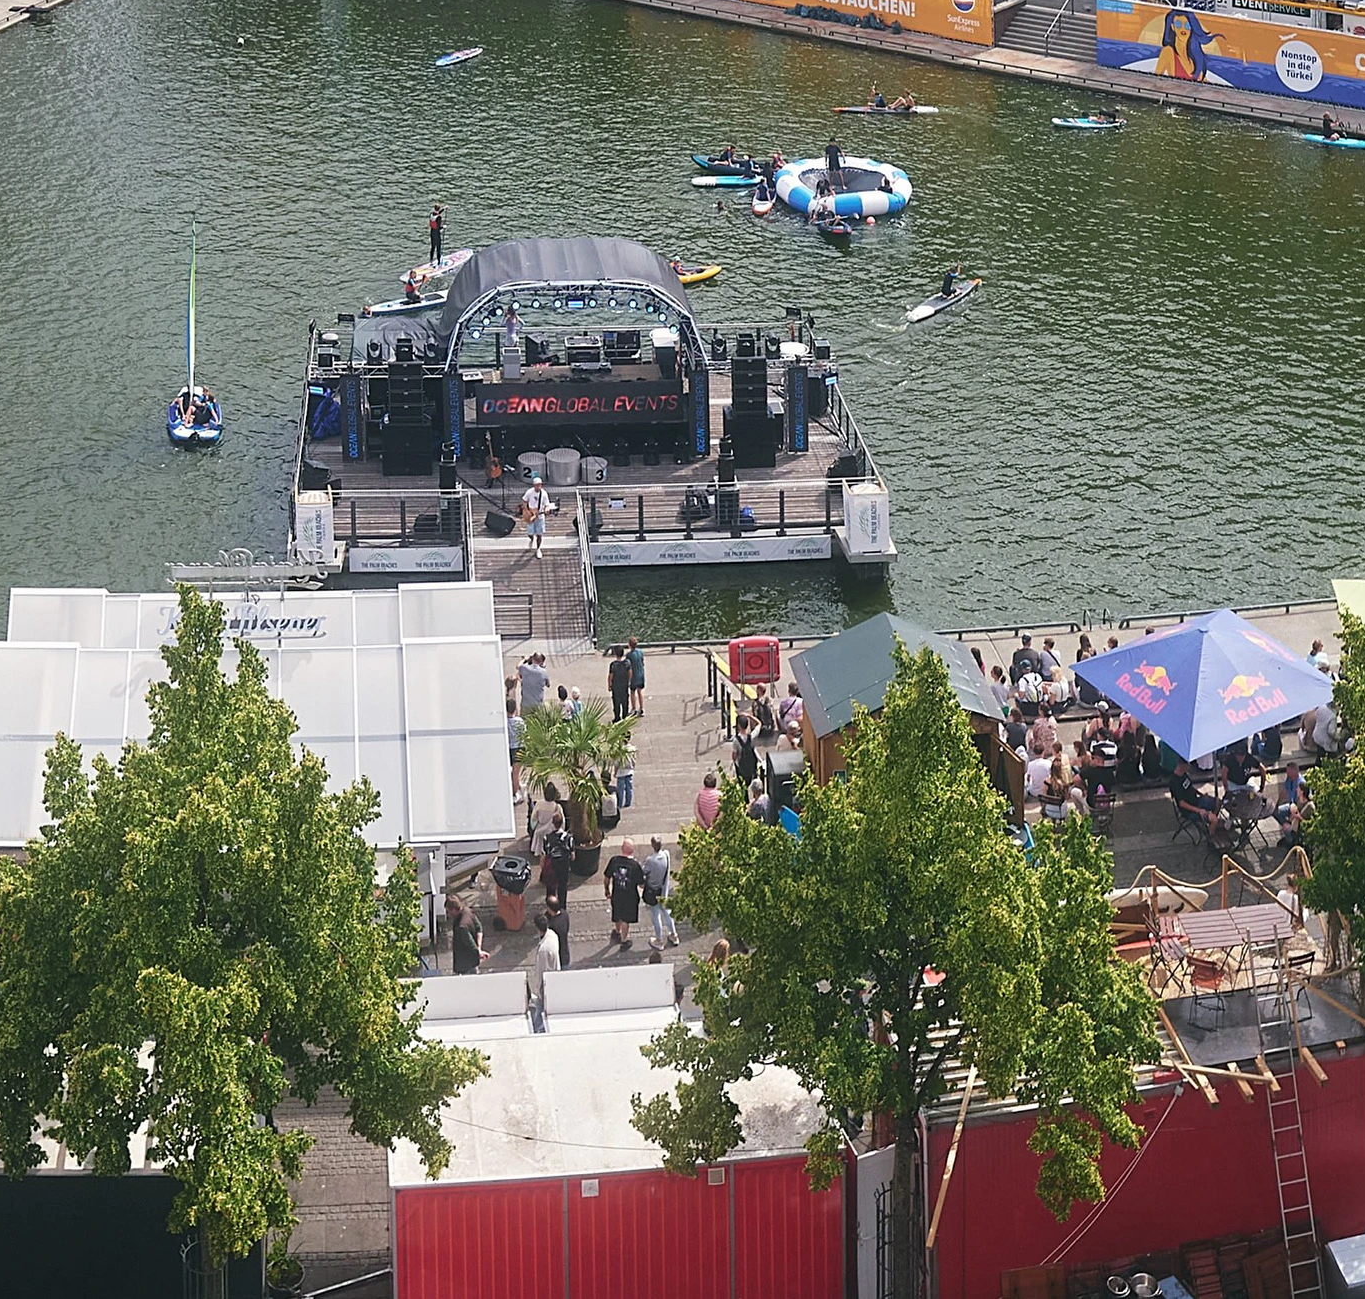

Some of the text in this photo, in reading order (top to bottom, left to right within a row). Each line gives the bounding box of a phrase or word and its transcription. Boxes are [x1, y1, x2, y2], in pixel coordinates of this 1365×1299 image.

[947, 13, 981, 30] SunExpress
[1280, 49, 1318, 65] Nonstop
[1287, 59, 1311, 73] in die
[1285, 68, 1314, 83] Türkei
[523, 466, 532, 479] 2
[595, 469, 604, 482] 3
[1115, 672, 1167, 716] Red Bull
[1224, 687, 1289, 726] Red Bull
